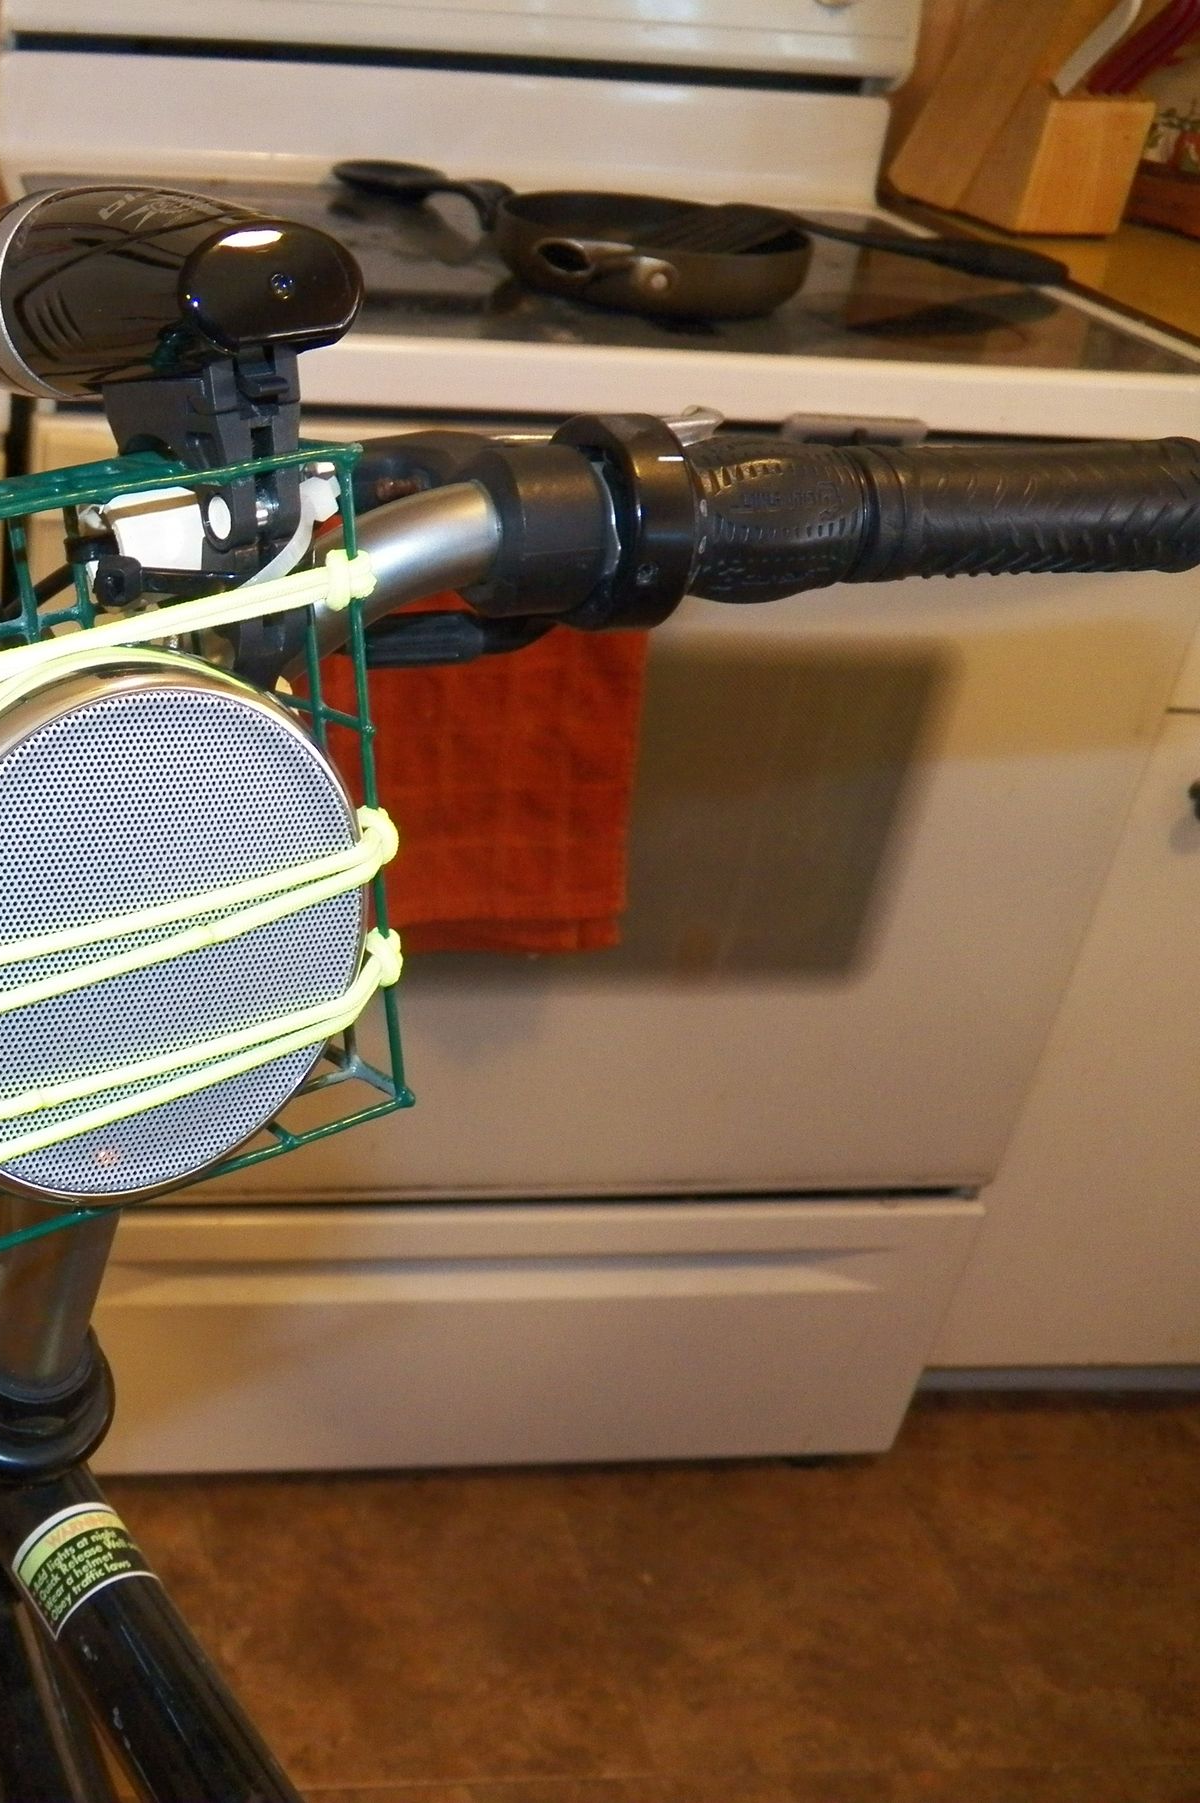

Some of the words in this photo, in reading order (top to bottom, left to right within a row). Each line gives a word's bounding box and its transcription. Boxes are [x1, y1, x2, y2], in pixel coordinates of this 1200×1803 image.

[39, 1573, 61, 1601] Quick
[59, 1544, 103, 1575] Release
[46, 1546, 76, 1572] lights
[76, 1537, 89, 1549] at
[90, 1529, 118, 1543] night
[66, 1576, 75, 1586] a
[73, 1552, 114, 1578] helmet
[51, 1593, 72, 1621] Obey
[71, 1568, 105, 1595] traffic
[104, 1560, 132, 1573] laws
